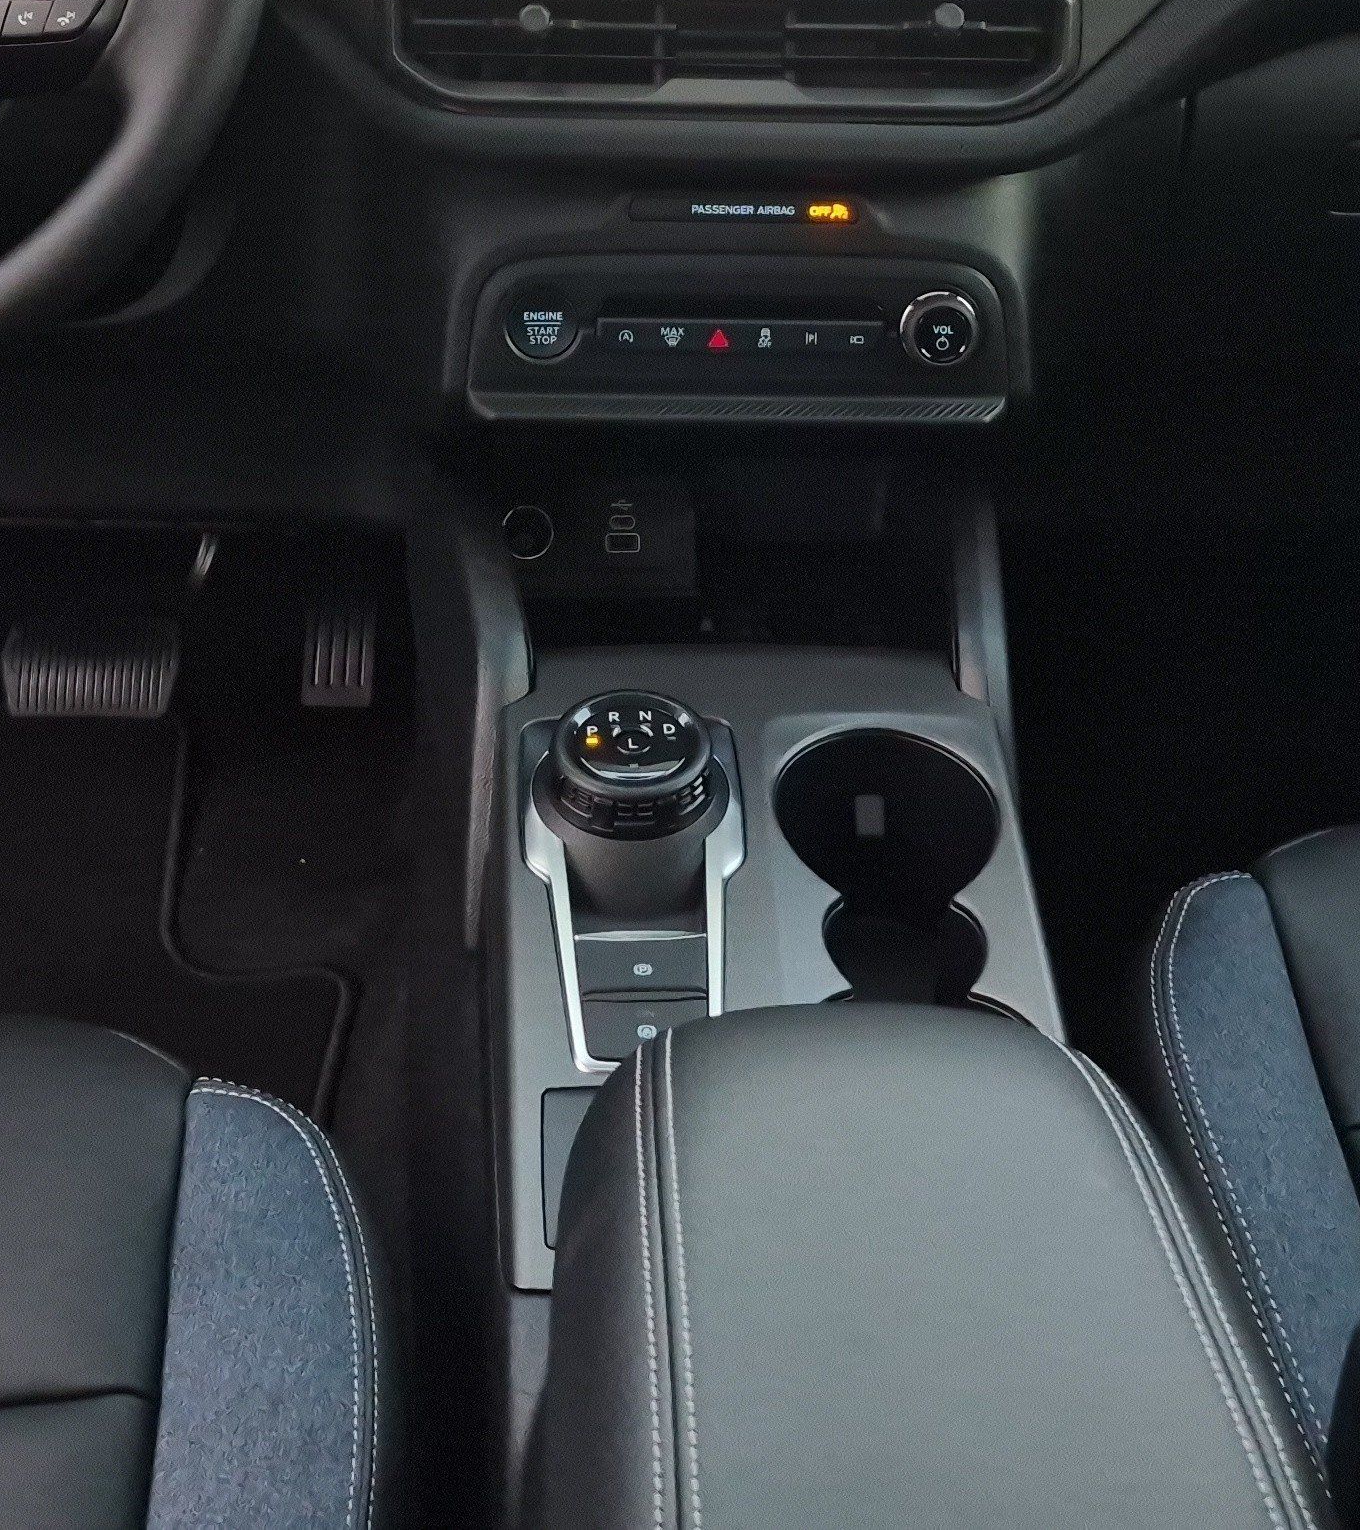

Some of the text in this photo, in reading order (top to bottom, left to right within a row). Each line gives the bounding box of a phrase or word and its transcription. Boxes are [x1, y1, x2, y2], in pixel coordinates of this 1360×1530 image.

[691, 205, 831, 216] PASSENGER AIRBAG OFF
[523, 311, 563, 320] ENGINE
[526, 326, 559, 336] START
[660, 327, 684, 336] MAX
[933, 325, 953, 335] VOL
[529, 335, 557, 345] STOP
[608, 710, 652, 722] R N
[586, 723, 676, 736] P D
[628, 738, 639, 749] L
